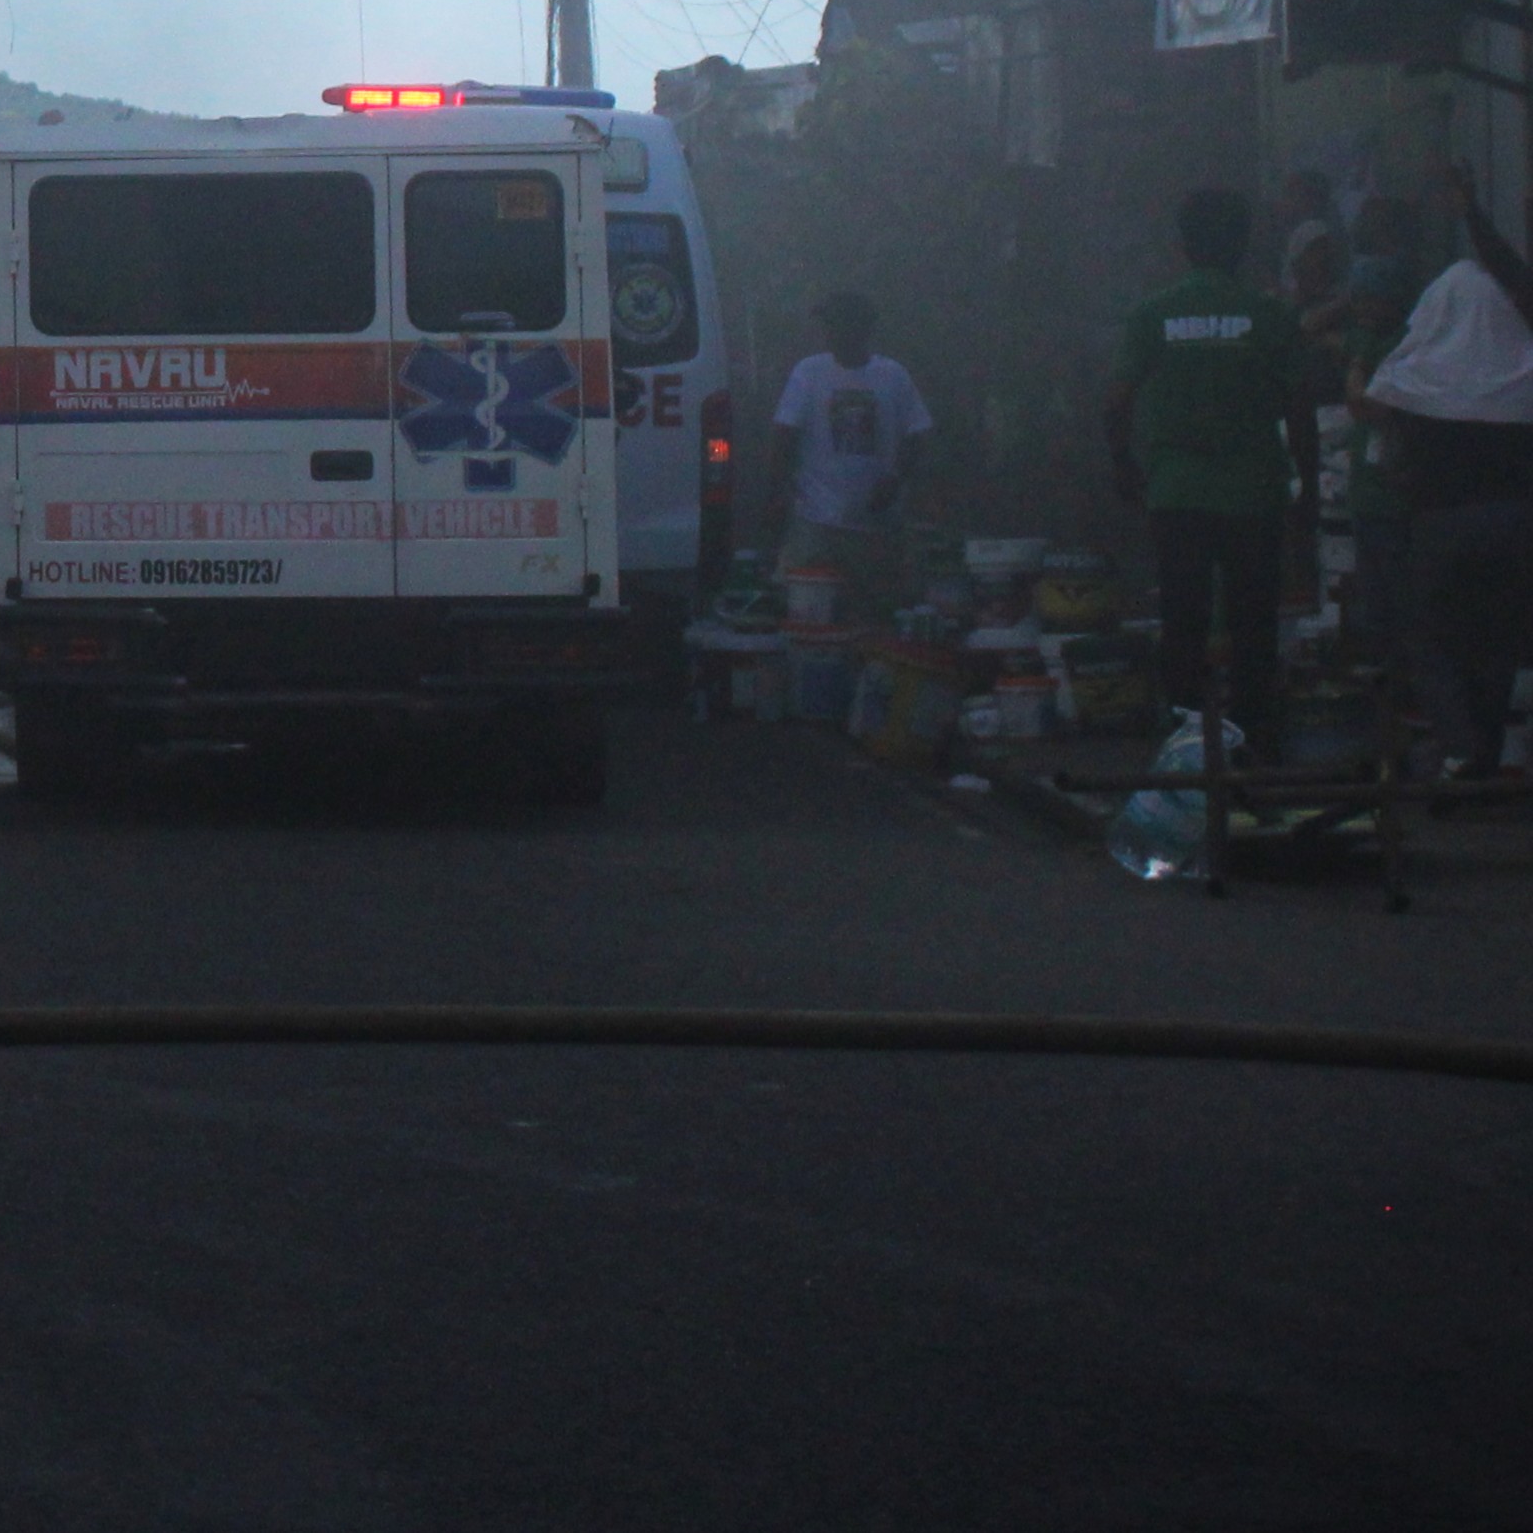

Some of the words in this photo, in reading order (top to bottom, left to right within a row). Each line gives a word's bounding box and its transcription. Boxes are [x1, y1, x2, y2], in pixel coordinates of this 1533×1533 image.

[1163, 315, 1253, 342] NBHP
[56, 396, 113, 409] NAVAL
[117, 396, 185, 409] RESCUE
[188, 395, 226, 408] UNIT
[70, 501, 194, 540] RESCUE
[203, 501, 394, 540] TRANSPORT
[404, 499, 537, 539] VEHICLE
[28, 560, 137, 585] HOTLINE:
